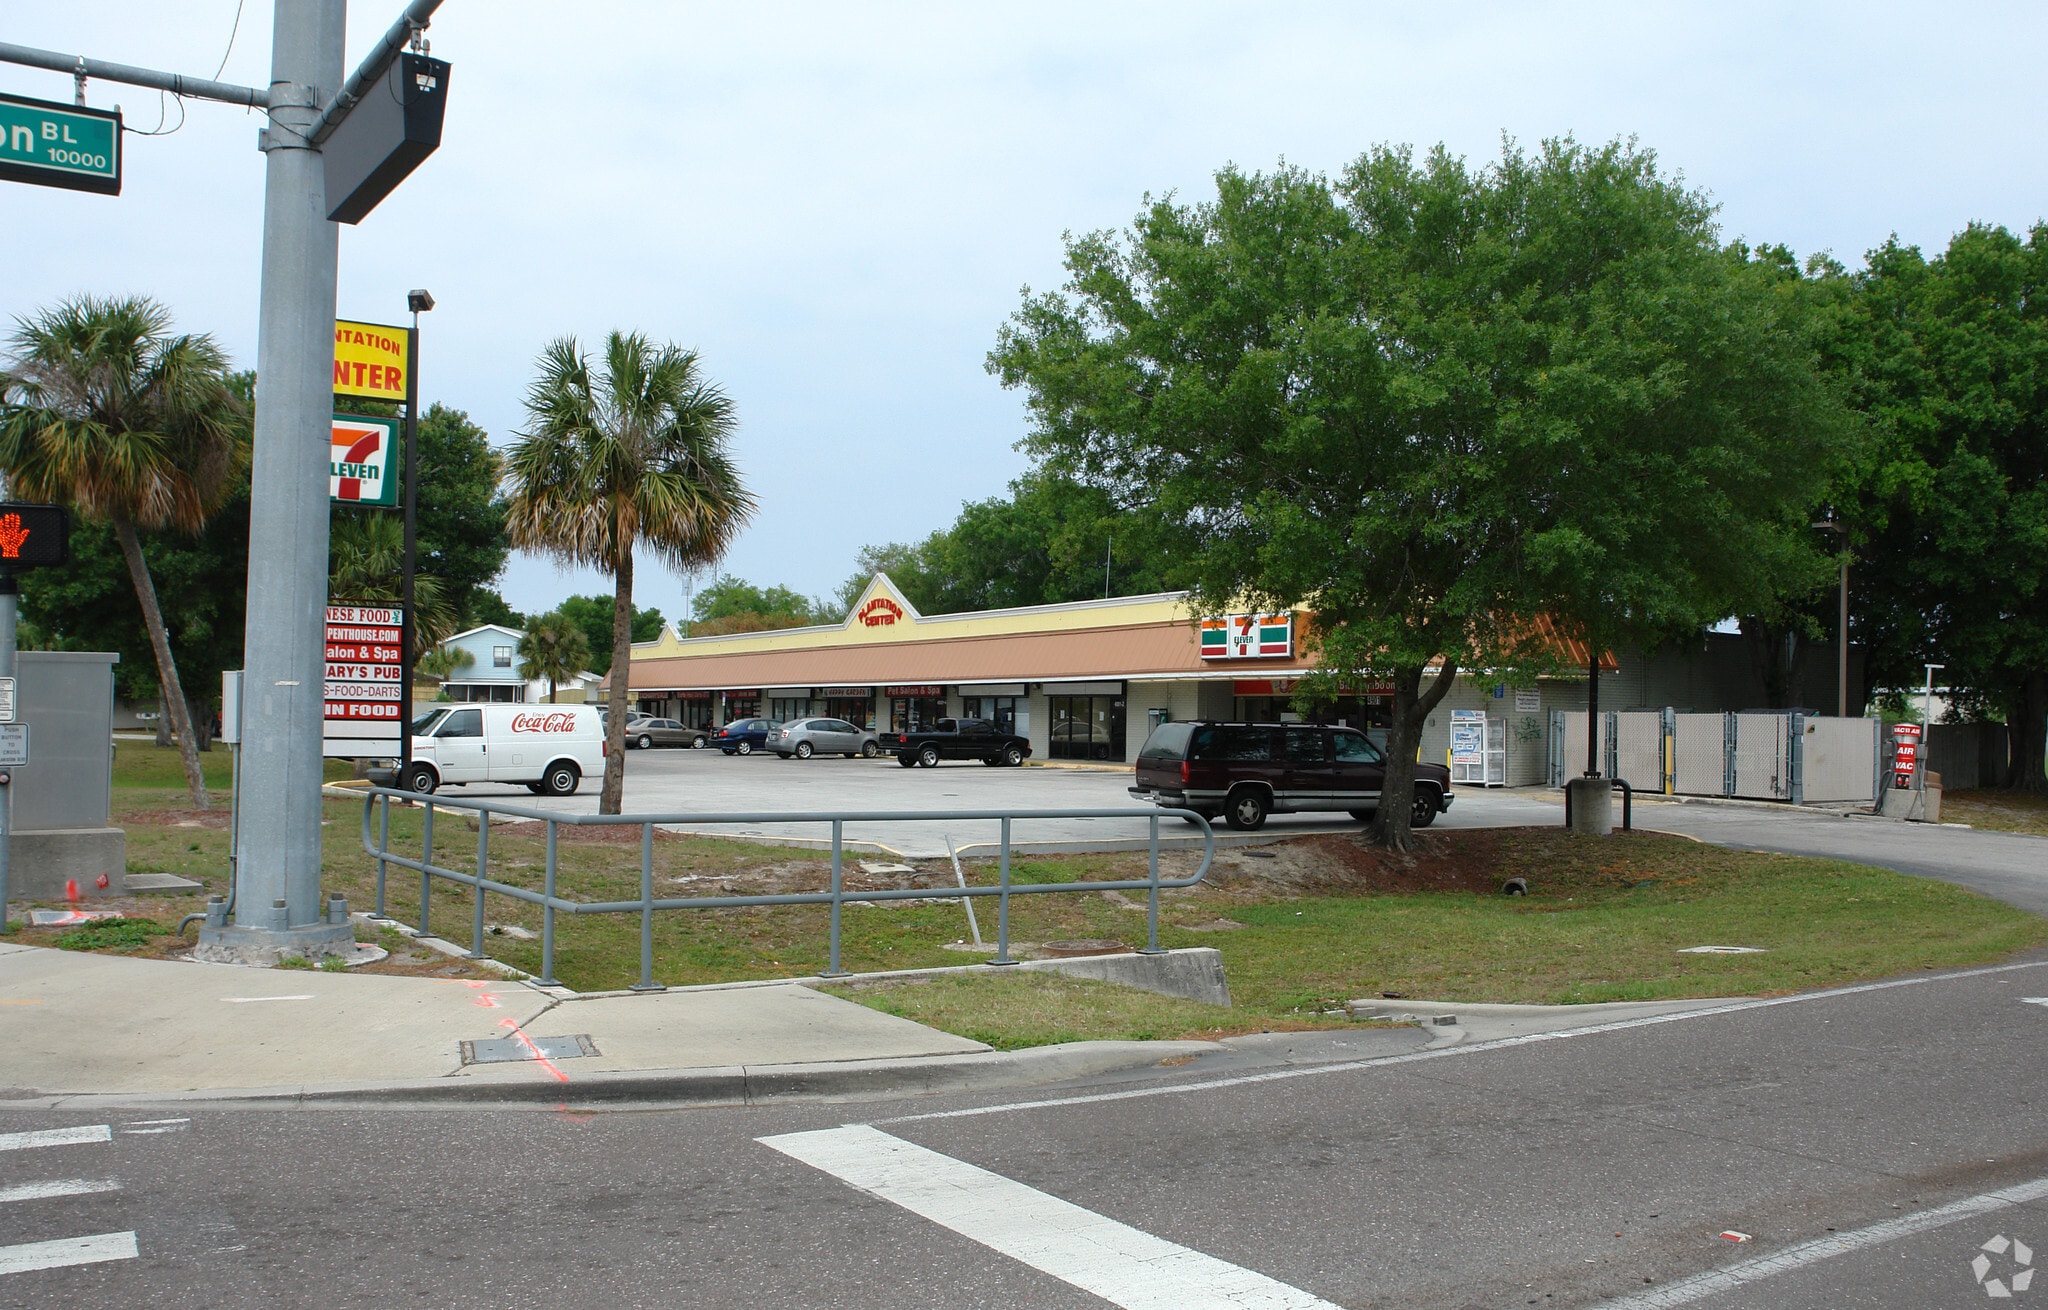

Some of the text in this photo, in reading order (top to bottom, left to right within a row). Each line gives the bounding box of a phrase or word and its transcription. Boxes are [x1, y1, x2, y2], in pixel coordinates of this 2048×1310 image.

[42, 121, 78, 144] BL
[47, 148, 106, 169] 10000
[333, 360, 402, 392] NTER
[359, 609, 391, 623] FOOD
[865, 614, 895, 627] CENTER
[327, 628, 399, 642] PENTHOUSE.COM
[359, 646, 370, 659] &
[373, 646, 398, 662] Spa
[325, 665, 401, 679] ARY'S PUB
[900, 686, 919, 695] Salon
[928, 685, 941, 696] Spa
[349, 704, 399, 717] FOOD
[511, 712, 577, 733] Coca-Cola
[1897, 747, 1915, 755] AIR
[1895, 761, 1914, 770] VAC
